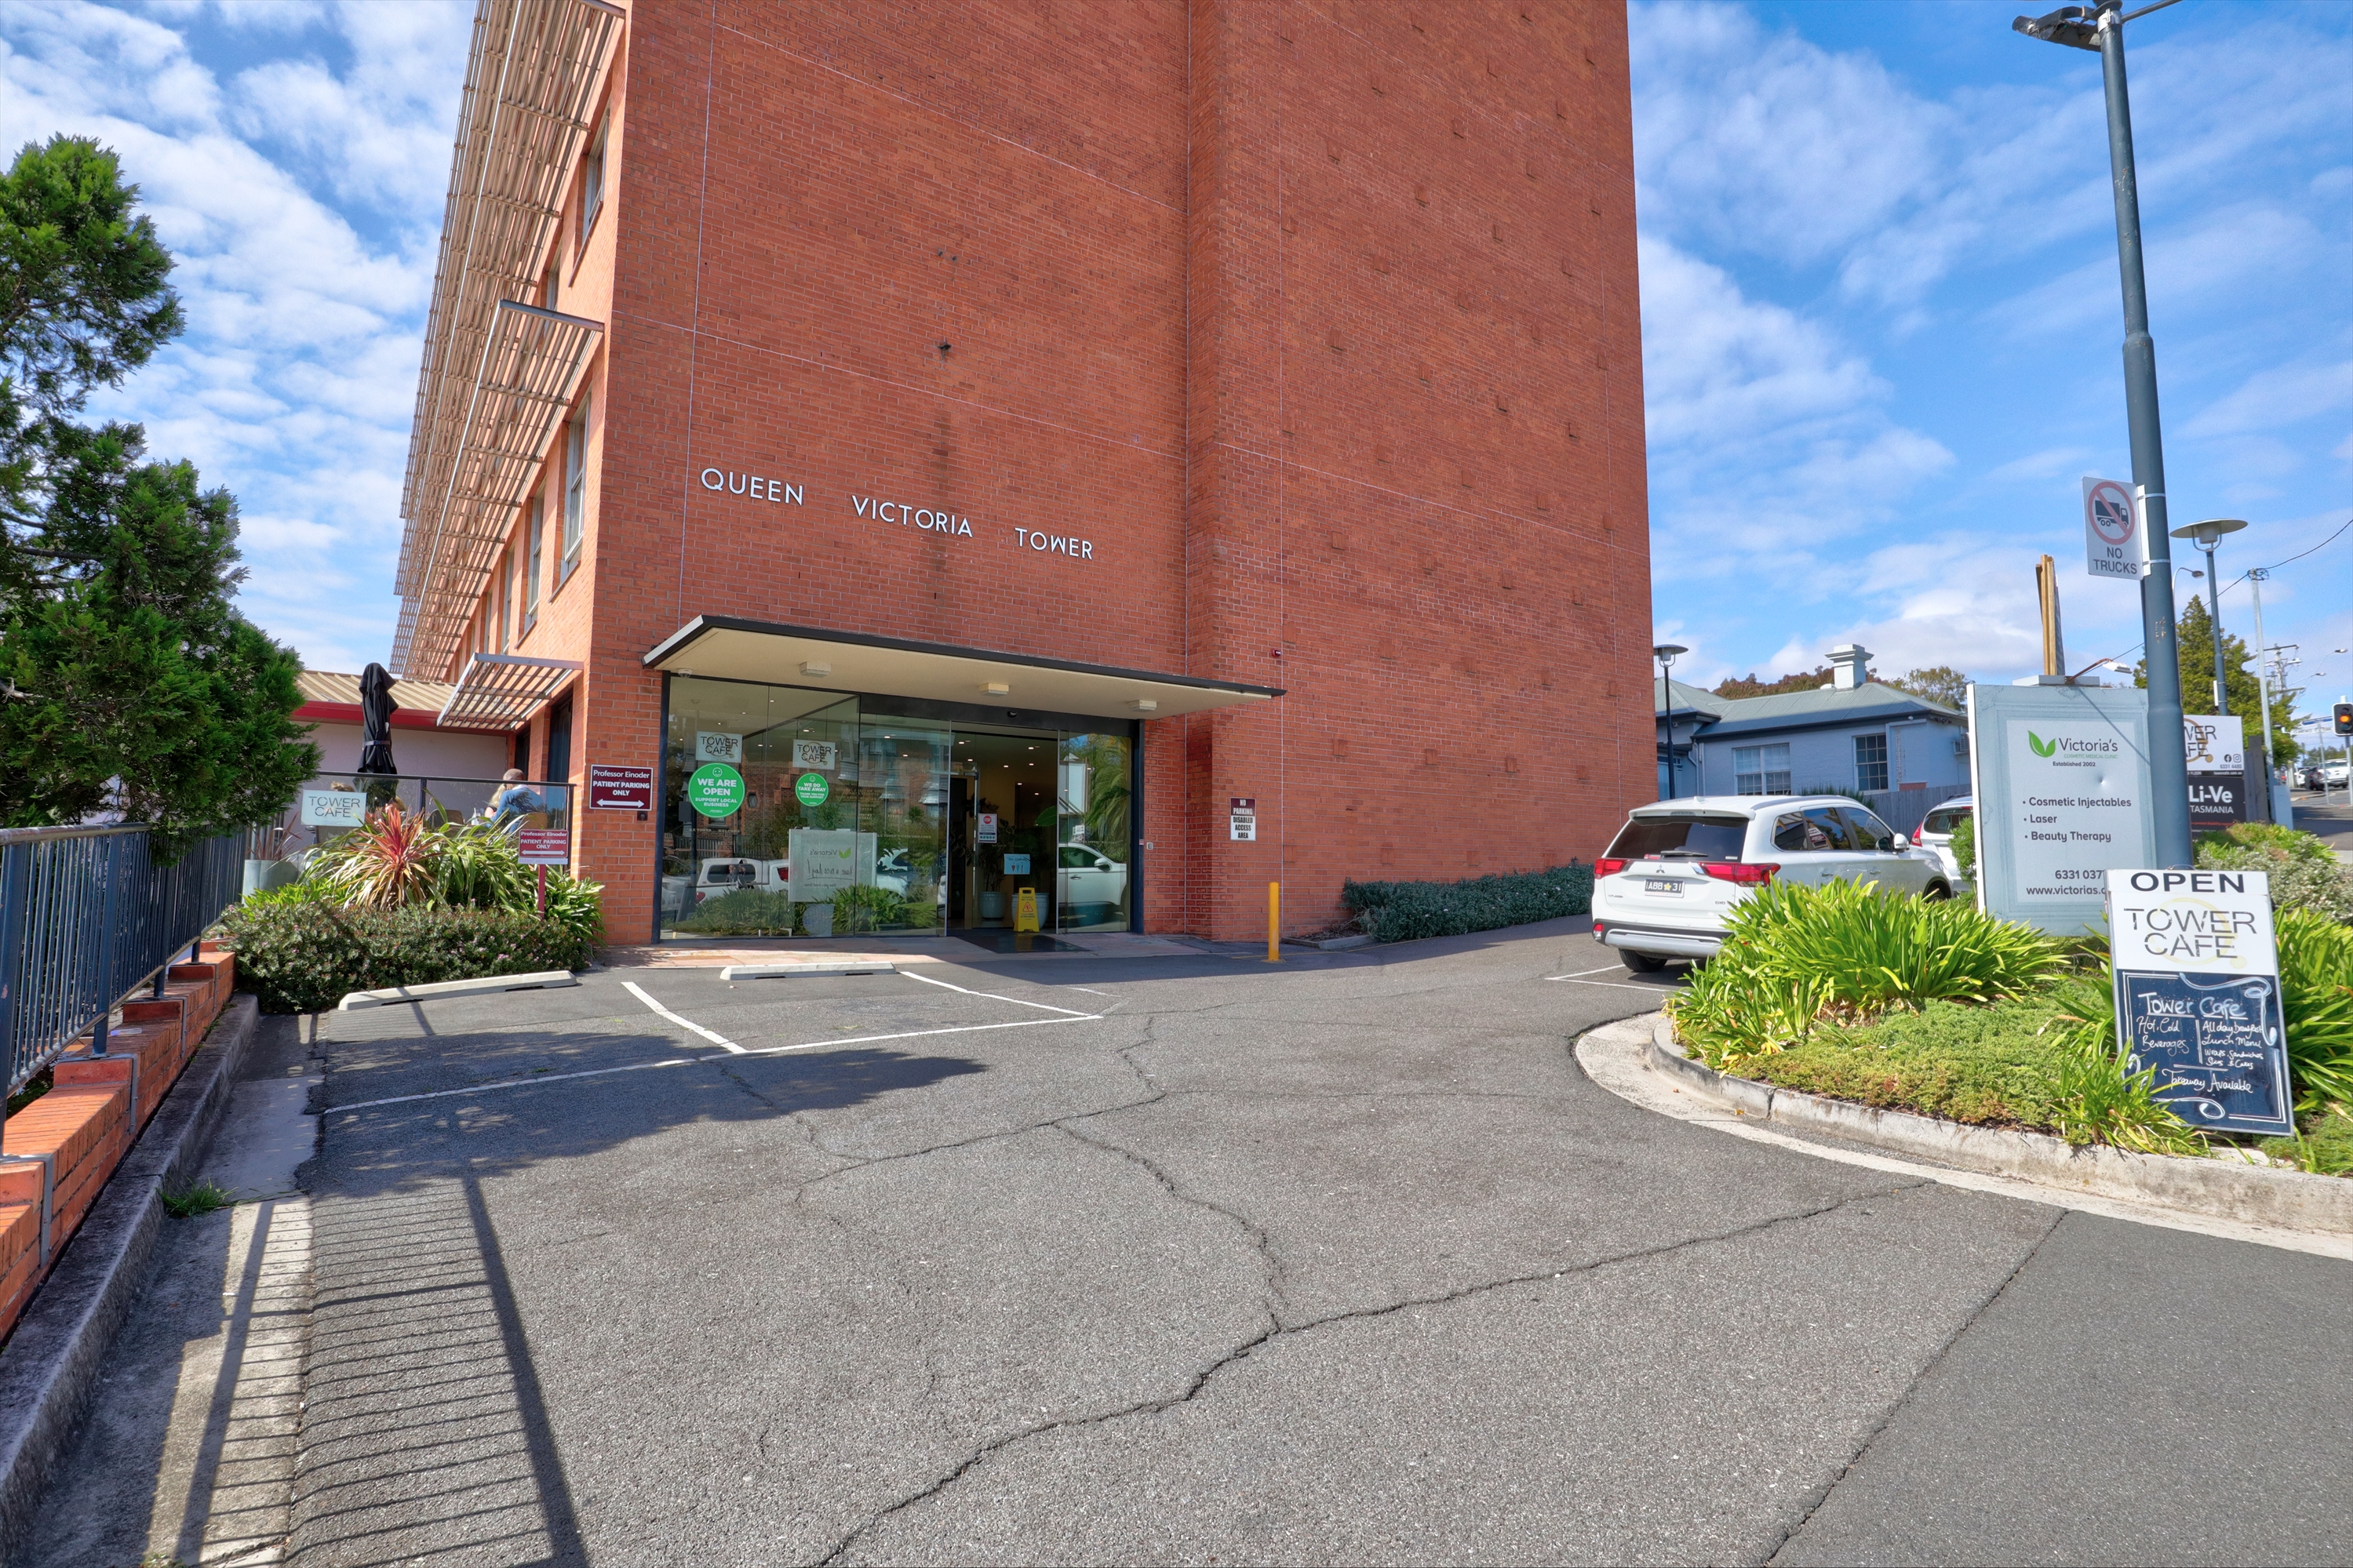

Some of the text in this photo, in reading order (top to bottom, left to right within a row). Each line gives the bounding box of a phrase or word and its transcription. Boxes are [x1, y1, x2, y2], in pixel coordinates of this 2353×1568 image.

[701, 467, 1093, 560] QUEEN VICTORIA TOWER
[2107, 547, 2123, 559] NO
[2093, 558, 2137, 575] TRUCKS
[700, 736, 738, 748] TOWER
[2059, 737, 2118, 752] Victoria's
[705, 744, 732, 755] CAFE
[797, 744, 832, 755] TOWER
[801, 752, 826, 762] CAFE
[716, 779, 737, 788] ARE
[702, 787, 730, 796] OPEN
[2188, 785, 2233, 803] Li-Ve
[308, 796, 360, 808] TOWER
[2029, 797, 2132, 808] Cosmetic Injectables
[315, 806, 351, 818] CAFE
[2190, 805, 2234, 814] TASMANIA
[2030, 814, 2057, 824] Laser
[2031, 831, 2111, 843] Beauty Therapy
[2055, 870, 2105, 879] 6331 037
[2130, 872, 2245, 893] OPEN
[2124, 908, 2257, 934] TOWER
[2144, 933, 2238, 959] CAFE
[2138, 992, 2246, 1020] Tower Cafe
[2159, 1017, 2180, 1033] Cold
[2202, 1020, 2216, 1033] All
[2216, 1021, 2234, 1037] day
[2141, 1035, 2189, 1057] Beverages
[2202, 1034, 2262, 1049] Lunch Menu
[2162, 1068, 2253, 1093] Takeaway Available
